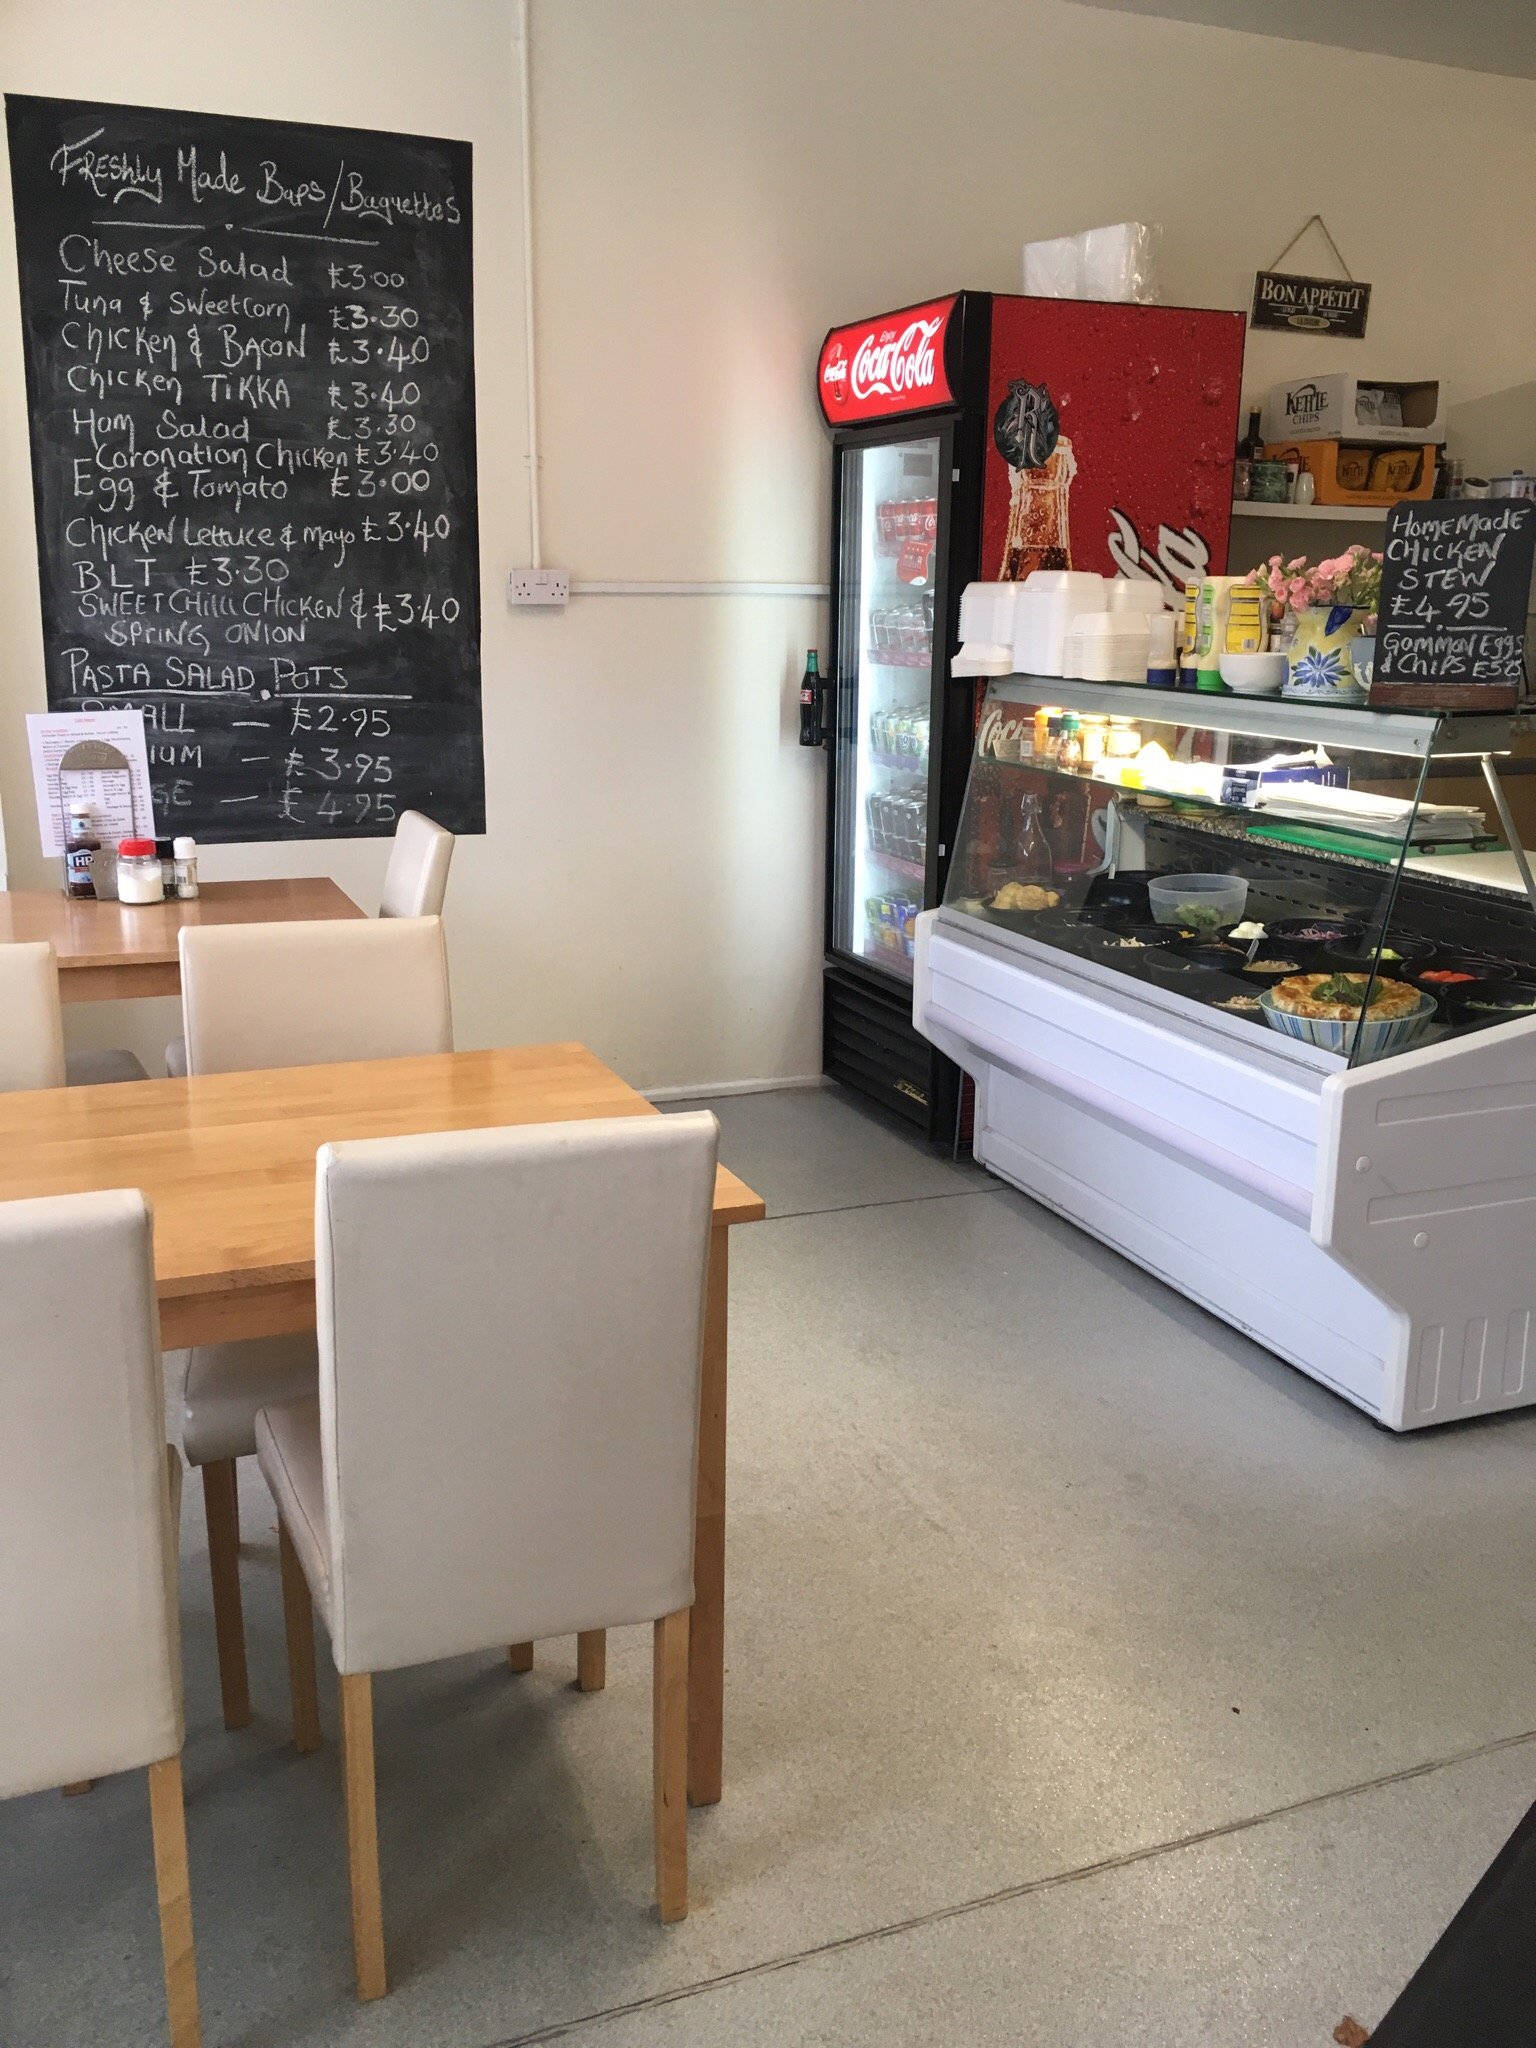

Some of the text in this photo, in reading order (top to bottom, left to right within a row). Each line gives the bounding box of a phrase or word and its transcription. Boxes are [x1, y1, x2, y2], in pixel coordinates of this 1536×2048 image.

[177, 144, 246, 203] Made
[59, 234, 405, 290] Cheese Salad £3.00
[58, 279, 122, 316] Tuna
[140, 291, 153, 321] &
[329, 305, 419, 331] £3.30
[1262, 278, 1298, 303] BON
[187, 324, 202, 368] &
[328, 336, 430, 373] £3.40
[328, 380, 421, 412] £3.40
[1285, 386, 1330, 416] KETTLE
[73, 408, 135, 454] Ham
[156, 409, 249, 443] Salad
[1292, 413, 1320, 425] CHIPS
[96, 442, 248, 478] Coronation
[355, 441, 439, 466] £3.40
[74, 458, 430, 513] Egg & Tomato £3.00
[183, 517, 275, 548] Lettuce
[280, 523, 297, 551] &
[362, 509, 450, 556] £3.40
[185, 556, 290, 586] £3.30
[1398, 561, 1496, 590] STEW
[350, 588, 368, 630] &
[372, 592, 460, 632] £3.40
[225, 617, 309, 645] ONION
[61, 647, 150, 694] PASTA
[166, 656, 255, 691] SALAD
[291, 698, 391, 737] £2.95
[285, 747, 393, 784] £3.95
[75, 855, 93, 867] HP
